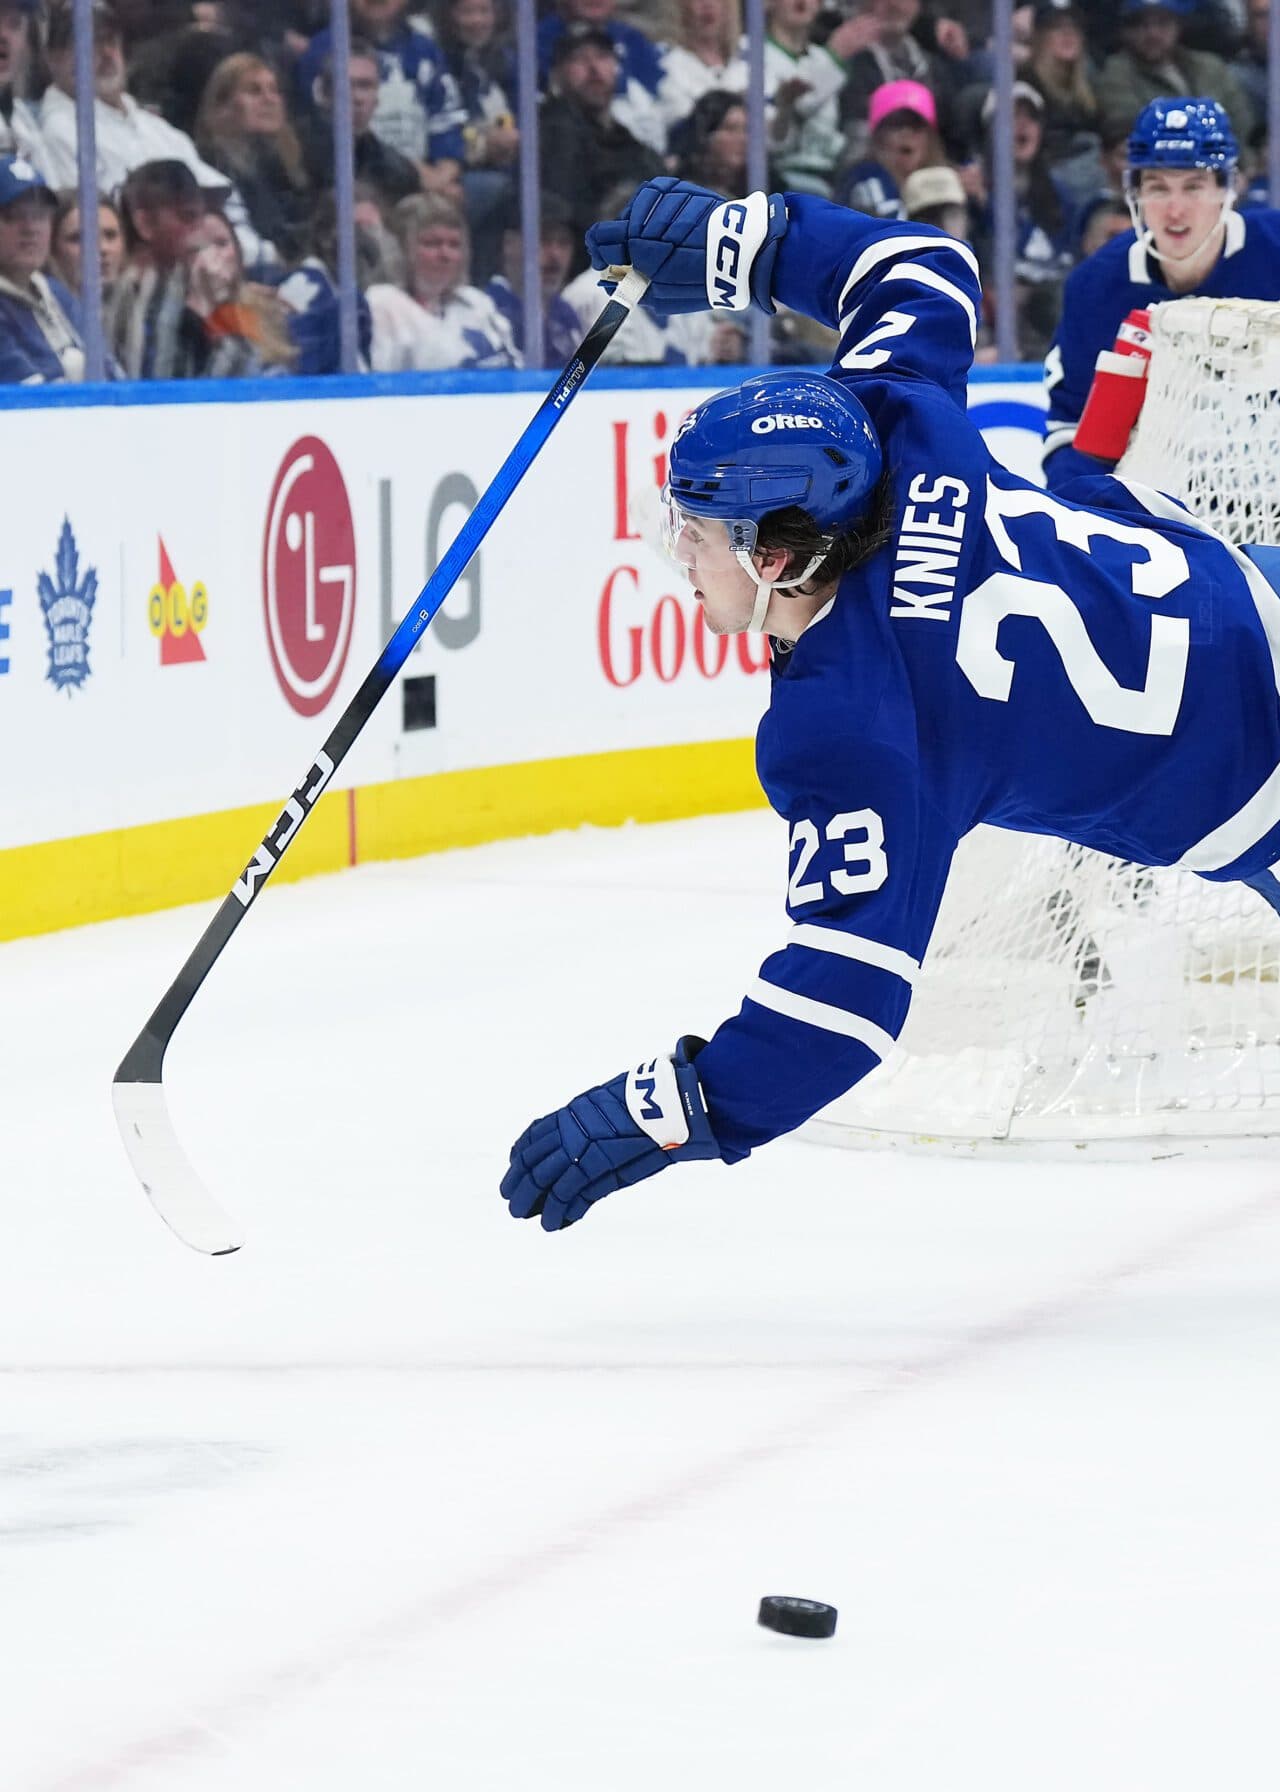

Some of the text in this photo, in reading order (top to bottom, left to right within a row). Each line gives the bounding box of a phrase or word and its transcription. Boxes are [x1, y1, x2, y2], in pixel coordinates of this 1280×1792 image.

[713, 203, 748, 309] CCM
[751, 413, 823, 434] OREO
[150, 587, 207, 629] OLG
[379, 470, 481, 652] LG
[889, 472, 970, 622] KNIES
[955, 472, 1191, 736] 23
[231, 750, 335, 907] CCM
[788, 807, 888, 908] 23
